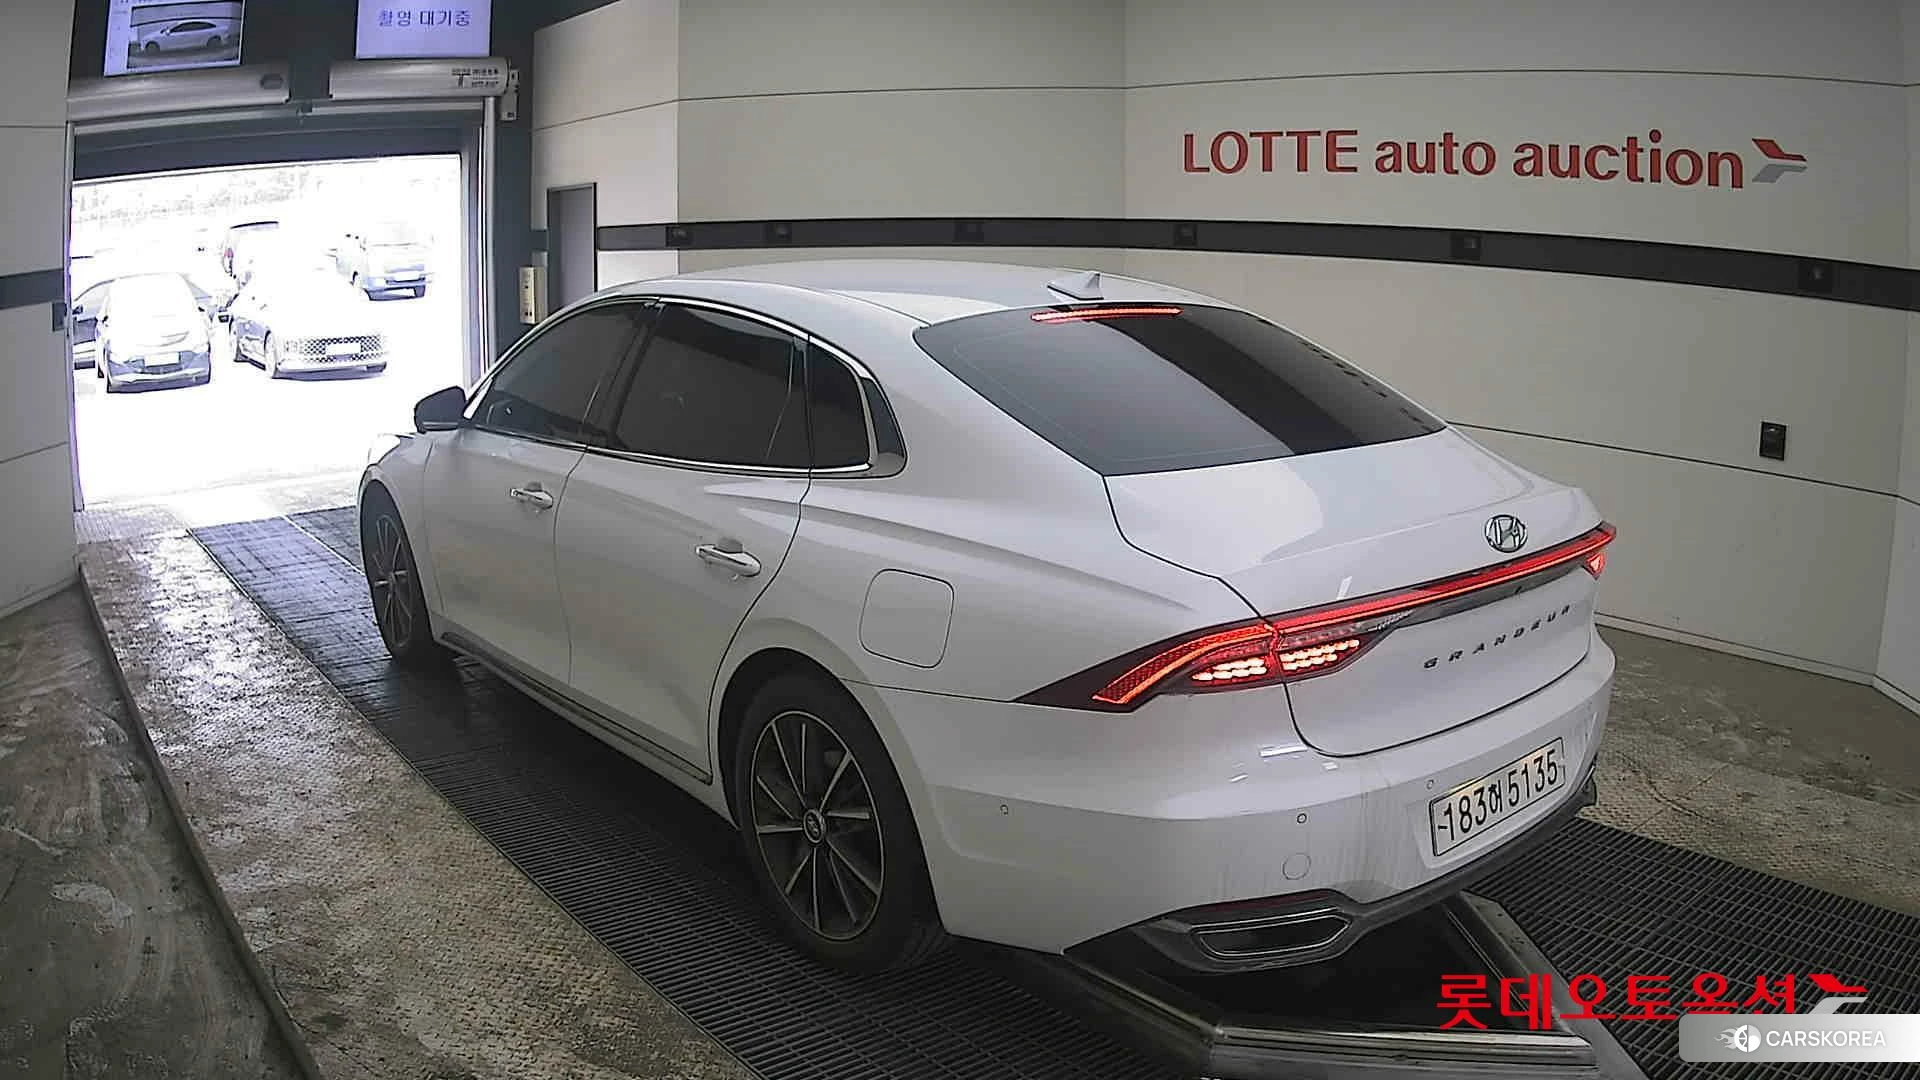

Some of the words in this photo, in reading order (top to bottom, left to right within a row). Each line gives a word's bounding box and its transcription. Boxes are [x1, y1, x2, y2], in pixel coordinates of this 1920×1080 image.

[1184, 130, 1358, 174] LOTTE
[1375, 132, 1496, 176] auto
[1512, 130, 1744, 188] auction
[1424, 605, 1570, 668] GRANDEUR
